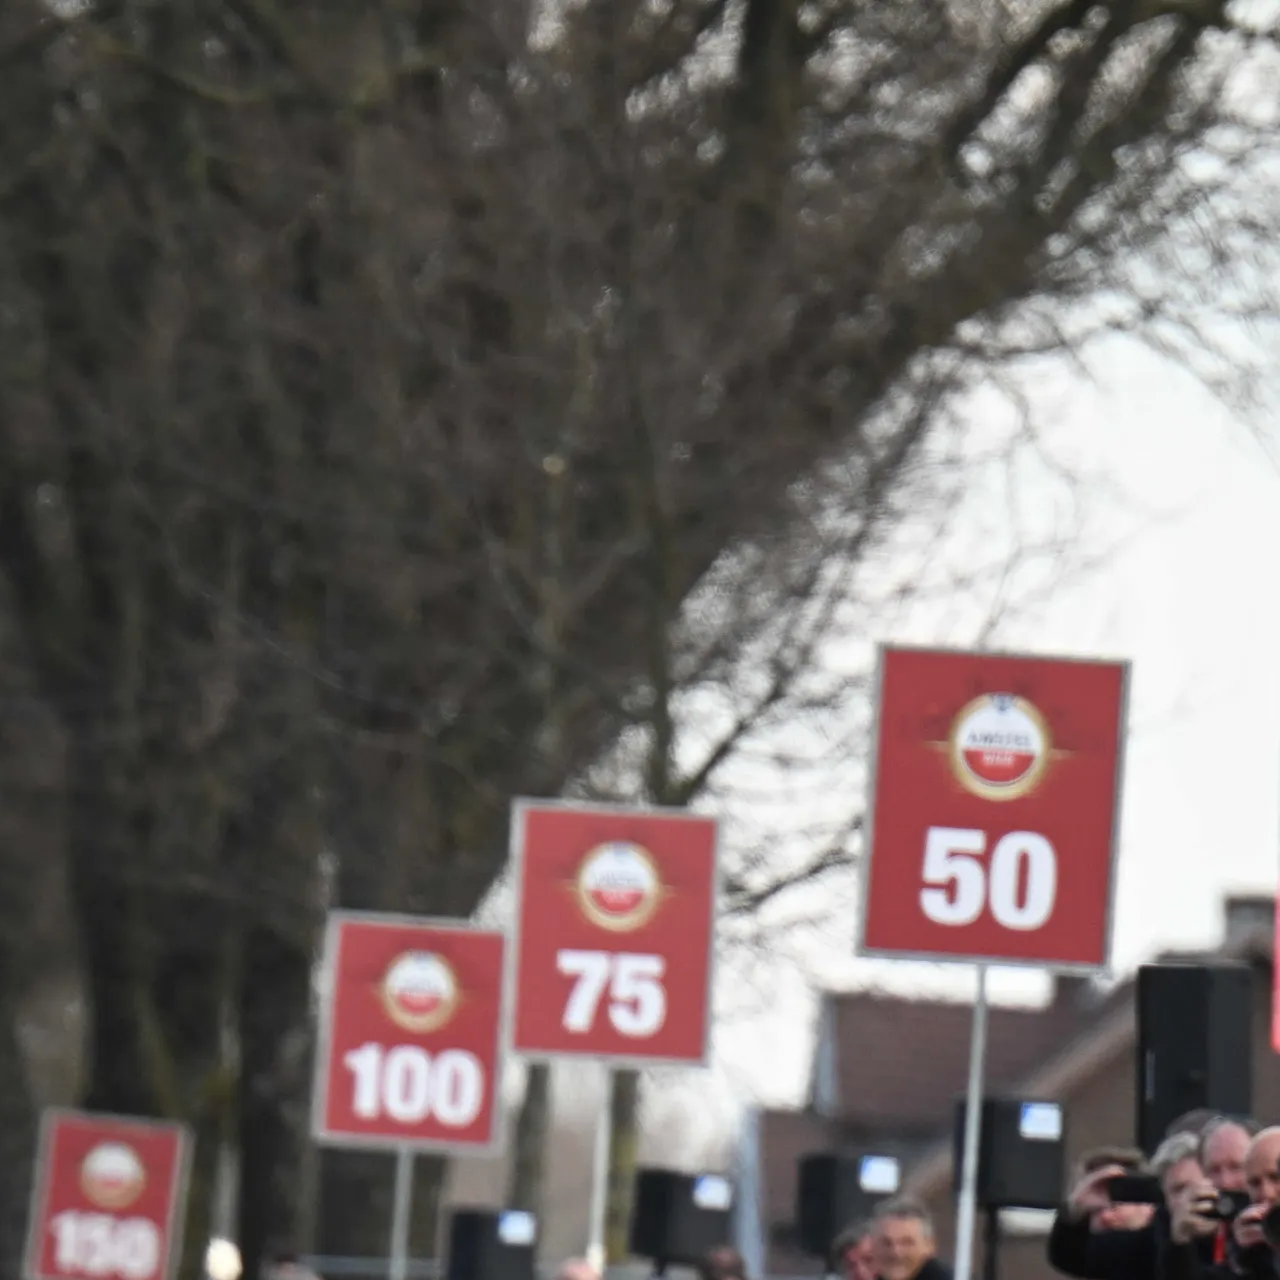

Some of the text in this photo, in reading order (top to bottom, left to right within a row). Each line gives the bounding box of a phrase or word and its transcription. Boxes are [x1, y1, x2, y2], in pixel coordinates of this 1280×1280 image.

[919, 825, 1059, 931] 50
[556, 948, 667, 1038] 75
[344, 1040, 485, 1129] 100
